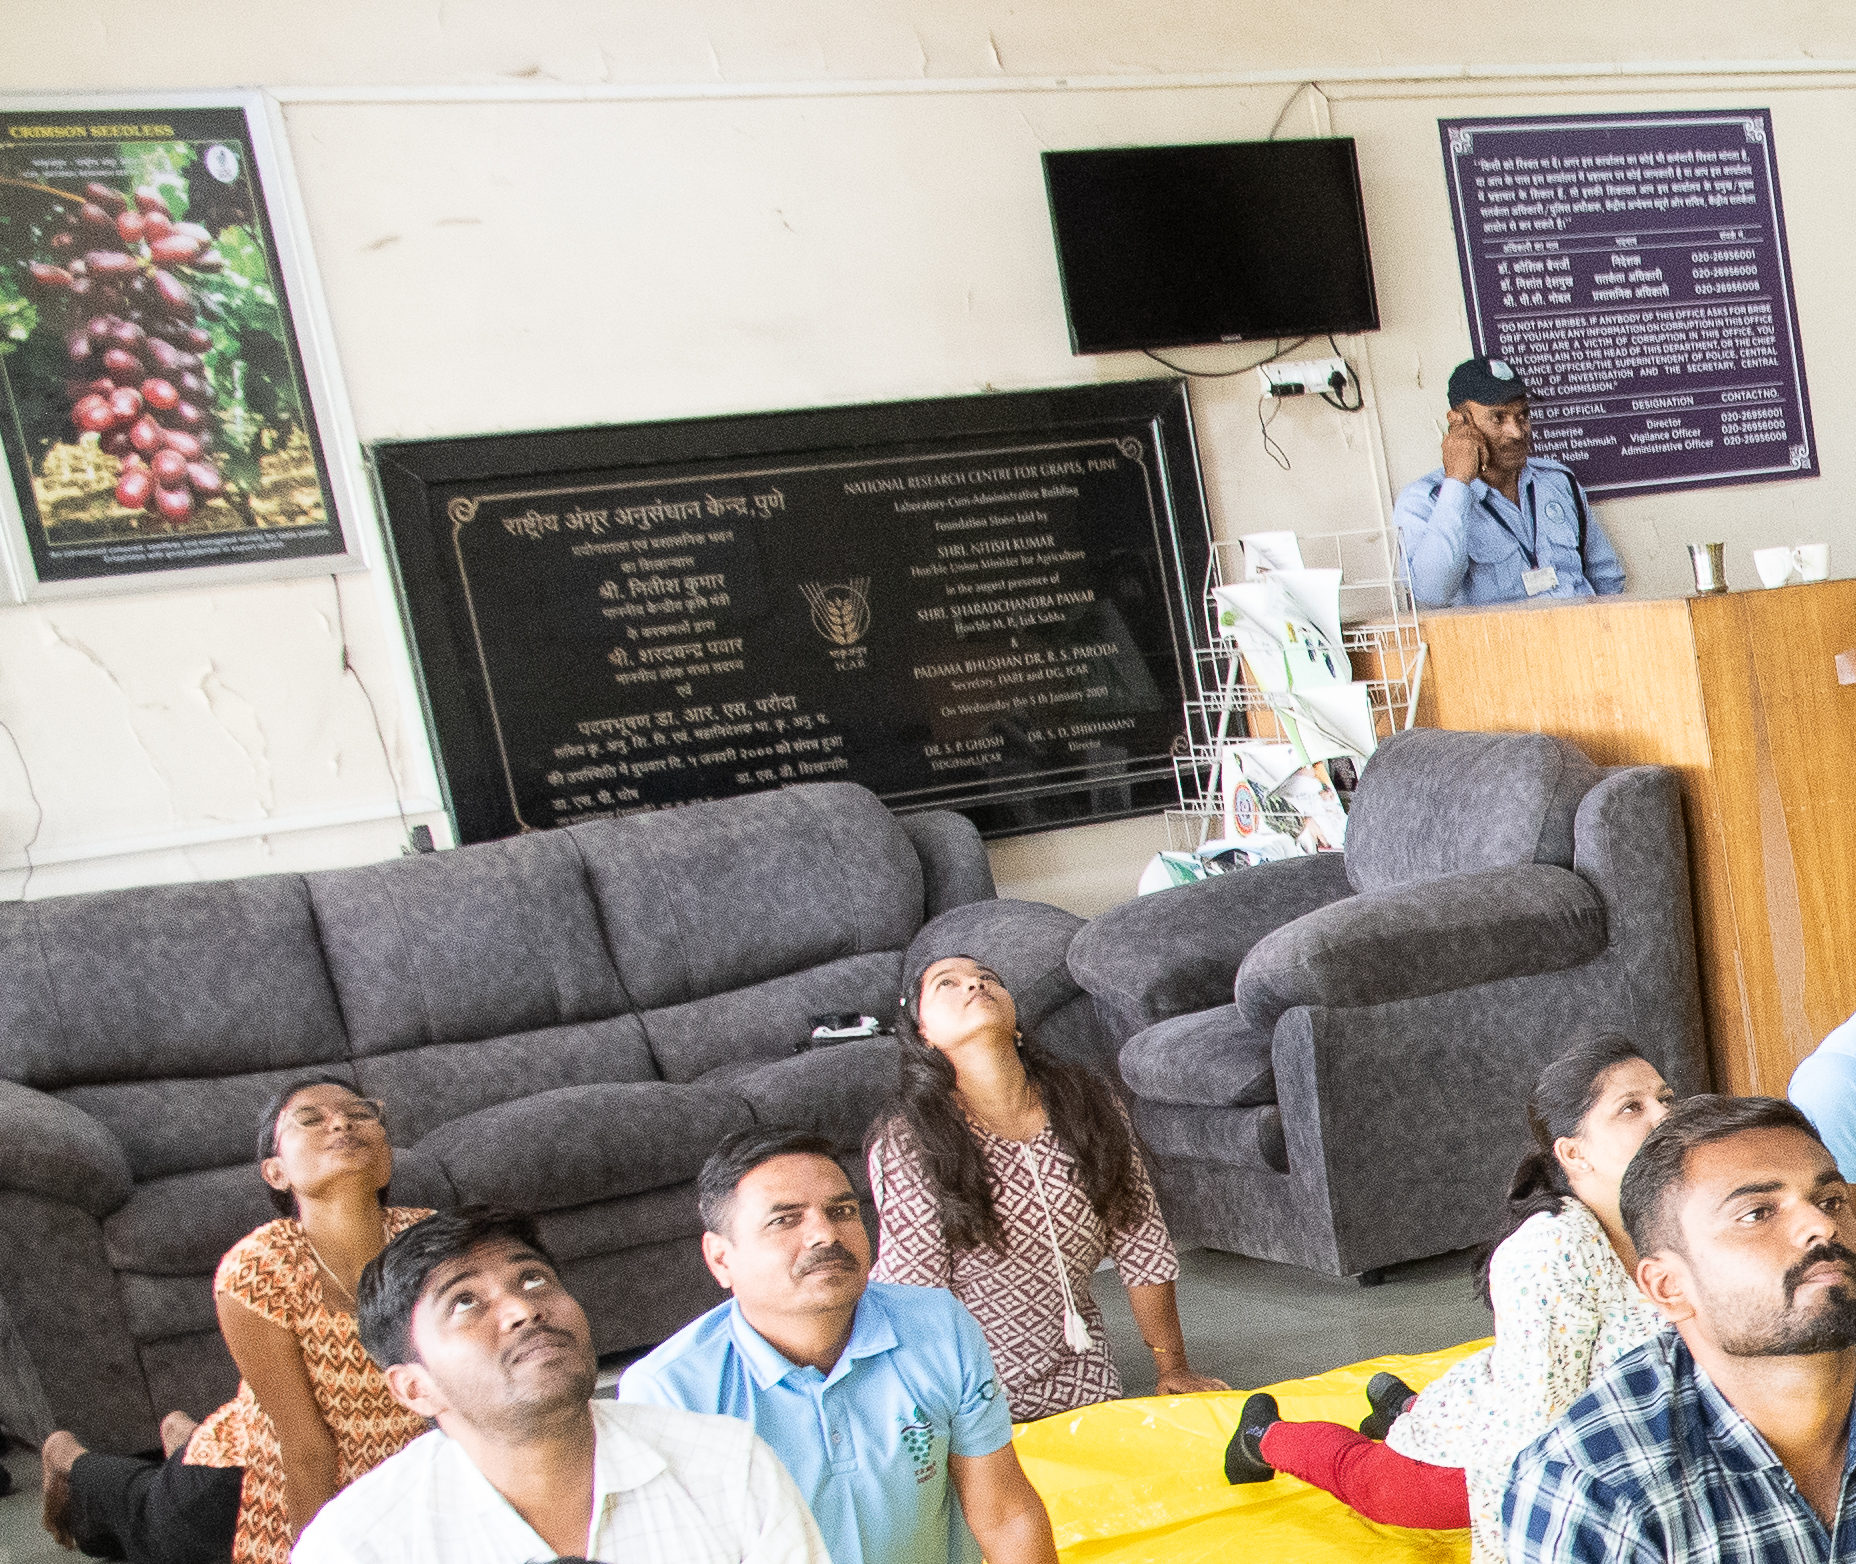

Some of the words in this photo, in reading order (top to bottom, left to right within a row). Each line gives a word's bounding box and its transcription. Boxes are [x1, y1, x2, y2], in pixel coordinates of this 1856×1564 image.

[9, 125, 87, 139] CRIMSON
[90, 124, 174, 137] SEEDLESS
[1516, 319, 1536, 331] NOT
[1536, 318, 1553, 329] PAY
[1589, 315, 1597, 326] IF
[1598, 312, 1640, 325] ANYBODY
[1641, 311, 1654, 322] OF
[1655, 310, 1674, 321] THIS
[1674, 308, 1705, 320] OFFICE
[1706, 306, 1728, 318] ASKS
[1728, 305, 1747, 316] FOR
[1746, 303, 1772, 315] BRIBE
[1498, 332, 1513, 343] OR
[1512, 331, 1522, 342] IF
[1521, 330, 1542, 341] YOU
[1541, 328, 1566, 340] HAVE
[1566, 327, 1585, 338] ANY
[1585, 323, 1645, 337] INFORMATION
[1645, 322, 1660, 332] ON
[1659, 318, 1715, 331] CORRUPTION
[1715, 317, 1724, 327] IN
[1724, 316, 1743, 327] THIS
[1743, 314, 1773, 325] OFFICE
[1500, 343, 1515, 354] OR
[1516, 342, 1527, 353] IF
[1529, 341, 1549, 352] YOU
[1550, 339, 1570, 351] ARE
[1572, 338, 1580, 349] A
[1582, 336, 1613, 348] VICTIM
[1614, 335, 1628, 346] OF
[1630, 331, 1686, 345] CORRUPTION
[1688, 330, 1699, 341] IN
[1700, 328, 1720, 340] THIS
[1757, 324, 1775, 336] YOU
[1522, 350, 1570, 364] COMPLAIN
[1571, 349, 1584, 360] TO
[1584, 347, 1603, 359] THE
[1602, 346, 1628, 358] HEAD
[1627, 345, 1642, 356] OF
[1642, 343, 1662, 355] THIS
[1719, 338, 1734, 349] OR
[1734, 337, 1751, 348] THE
[1751, 335, 1776, 347] CHIEF
[1614, 352, 1690, 368] SUPERINTENDENT
[1690, 351, 1704, 362] OF
[1738, 346, 1777, 359] CENTRAL
[1547, 373, 1562, 384] OF
[1567, 367, 1634, 383] INVESTIGATION
[1638, 365, 1659, 377] AND
[1663, 363, 1681, 375] THE
[1740, 356, 1779, 369] CENTRAL
[1631, 395, 1694, 410] DESIGNATION
[1720, 389, 1763, 402] CONTACT
[1545, 406, 1561, 418] OF
[1561, 402, 1607, 417] OFFICIAL
[1542, 425, 1584, 441] Banerjee
[1645, 415, 1682, 429] Director
[1533, 439, 1568, 452] Nishant
[1569, 434, 1617, 449] Deshmukh
[1629, 429, 1670, 444] Vigilance
[1670, 426, 1701, 439] Officer
[1561, 449, 1590, 462] Noble
[1619, 440, 1683, 456] Administrative
[1683, 437, 1714, 450] Officer
[843, 477, 905, 496] NATIONAL
[906, 471, 966, 490] RESEARCH
[967, 466, 1011, 483] CENTRE
[1013, 463, 1039, 479] FOR
[500, 507, 562, 543] राष्ट्रीय
[561, 503, 612, 538] अंगूर
[611, 494, 704, 533] अनुसंधान
[968, 538, 1011, 555] NITISH
[1012, 533, 1055, 551] KUMAR
[626, 573, 680, 598] नितीश
[682, 572, 727, 597] कुमार
[949, 593, 1055, 618] SHARADCHANDRA
[1055, 588, 1095, 606] PAWAR
[705, 636, 745, 656] पवार
[912, 660, 963, 679] PADAMA
[963, 653, 1022, 673] BHUSHAN
[1072, 642, 1119, 660] PARODA
